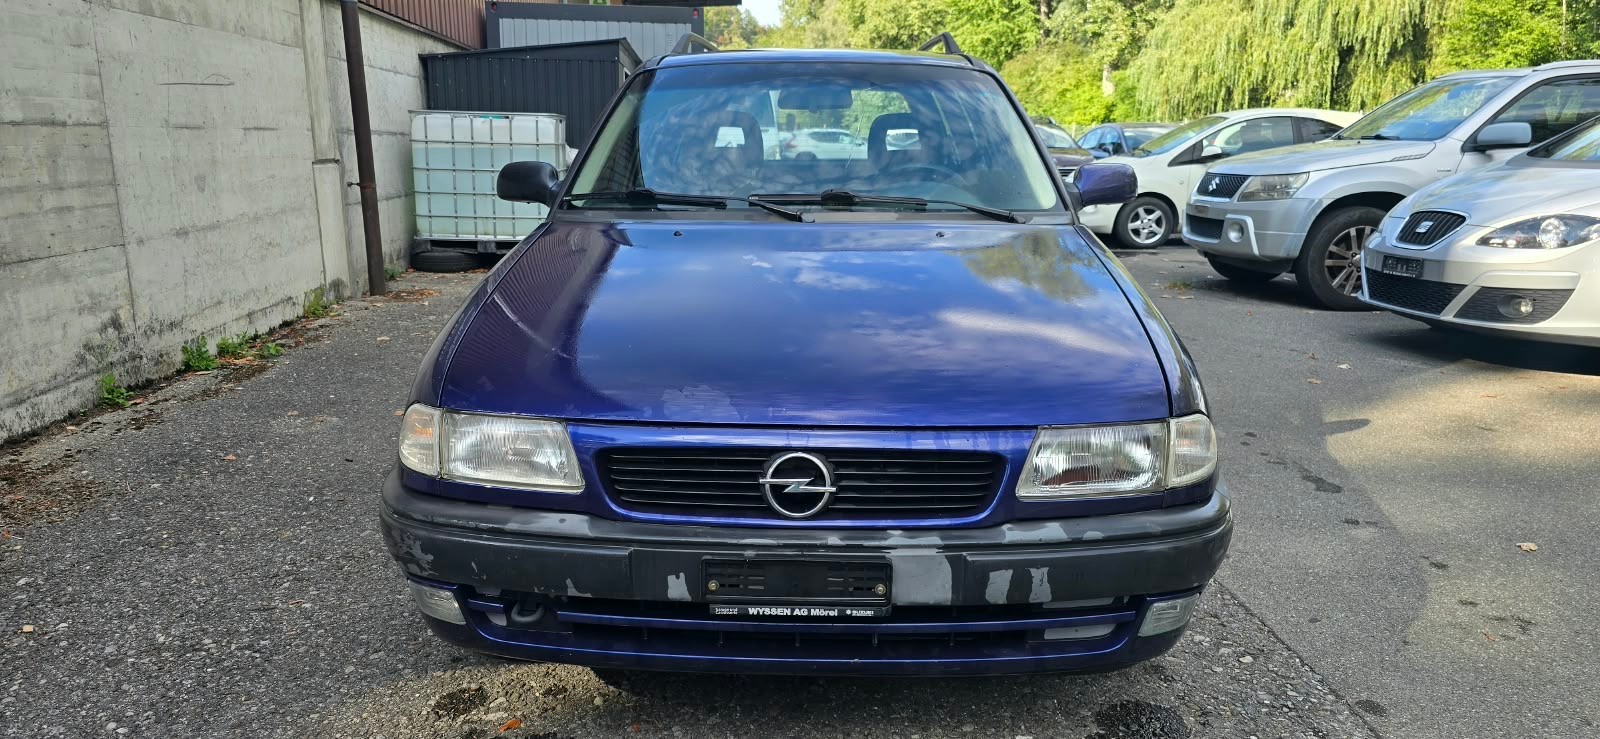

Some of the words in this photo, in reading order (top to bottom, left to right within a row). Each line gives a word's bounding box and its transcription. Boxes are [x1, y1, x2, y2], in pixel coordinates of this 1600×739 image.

[748, 607, 791, 616] WYSSEN
[793, 608, 808, 616] AG
[810, 608, 838, 617] Mörel
